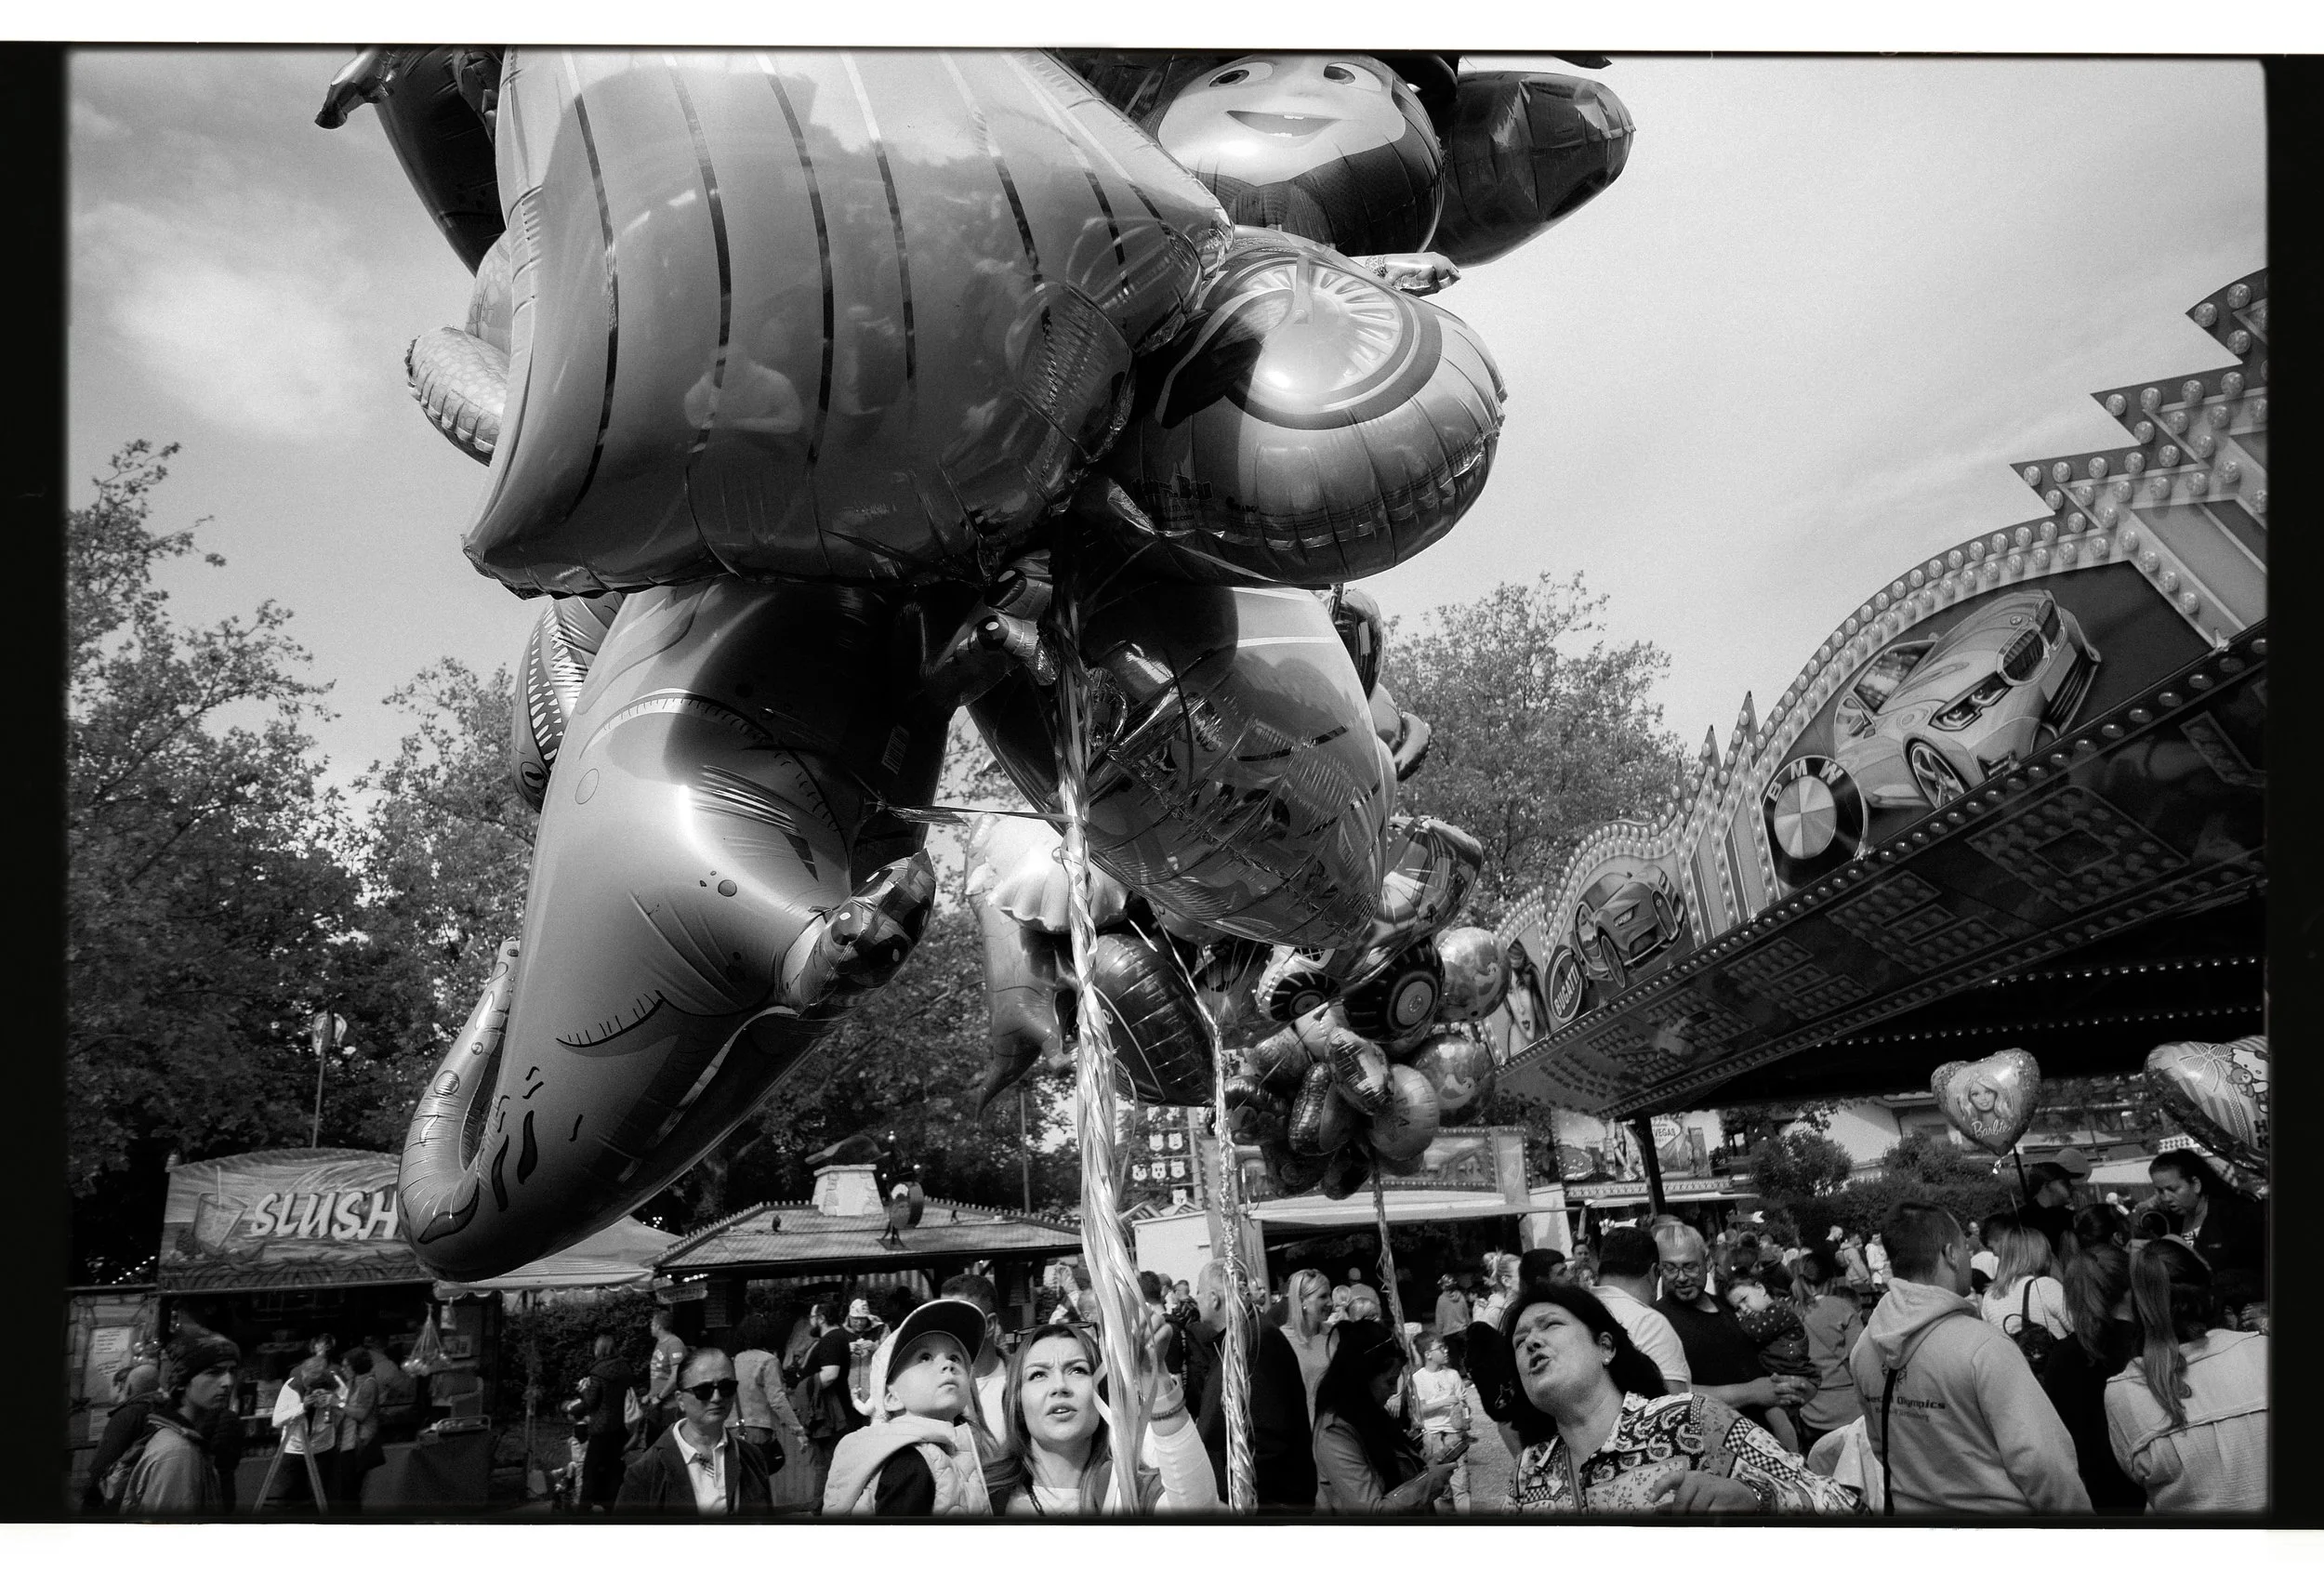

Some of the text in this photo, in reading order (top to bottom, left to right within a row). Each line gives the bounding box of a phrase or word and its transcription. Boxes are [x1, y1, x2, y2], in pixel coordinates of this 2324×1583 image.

[1767, 759, 1844, 802] BMW
[1554, 962, 1579, 1017] BUGATTI
[1653, 1128, 1676, 1137] VEGAS
[1971, 1118, 2012, 1139] Barbie
[251, 1191, 399, 1241] SLUSH
[1897, 1396, 1946, 1409] Olympics
